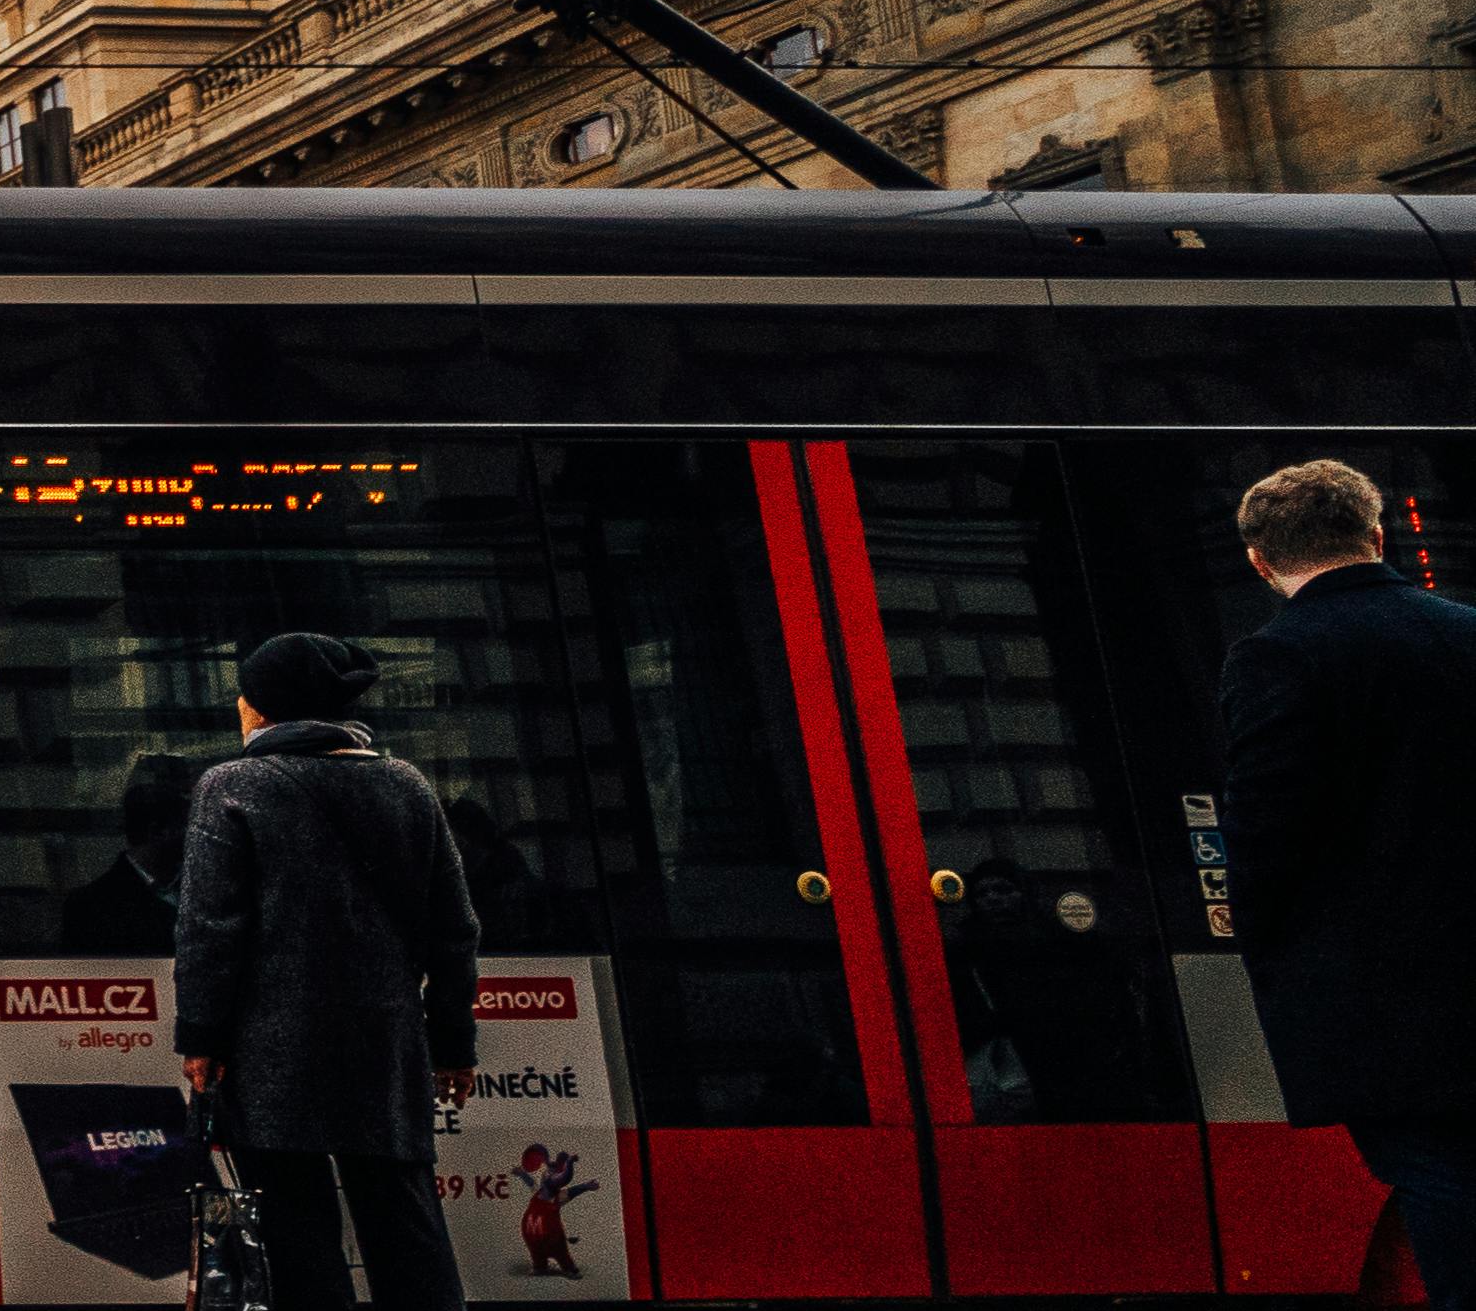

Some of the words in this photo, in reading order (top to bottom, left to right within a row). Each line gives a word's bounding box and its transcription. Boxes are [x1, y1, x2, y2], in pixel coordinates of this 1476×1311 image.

[5, 985, 150, 1015] MALL.CZ
[472, 991, 566, 1009] enovo
[58, 1037, 72, 1050] by
[78, 1028, 153, 1053] allegro
[469, 1066, 579, 1098] INEČNÉ
[86, 1129, 167, 1151] LEGION
[475, 1174, 510, 1200] Kč
